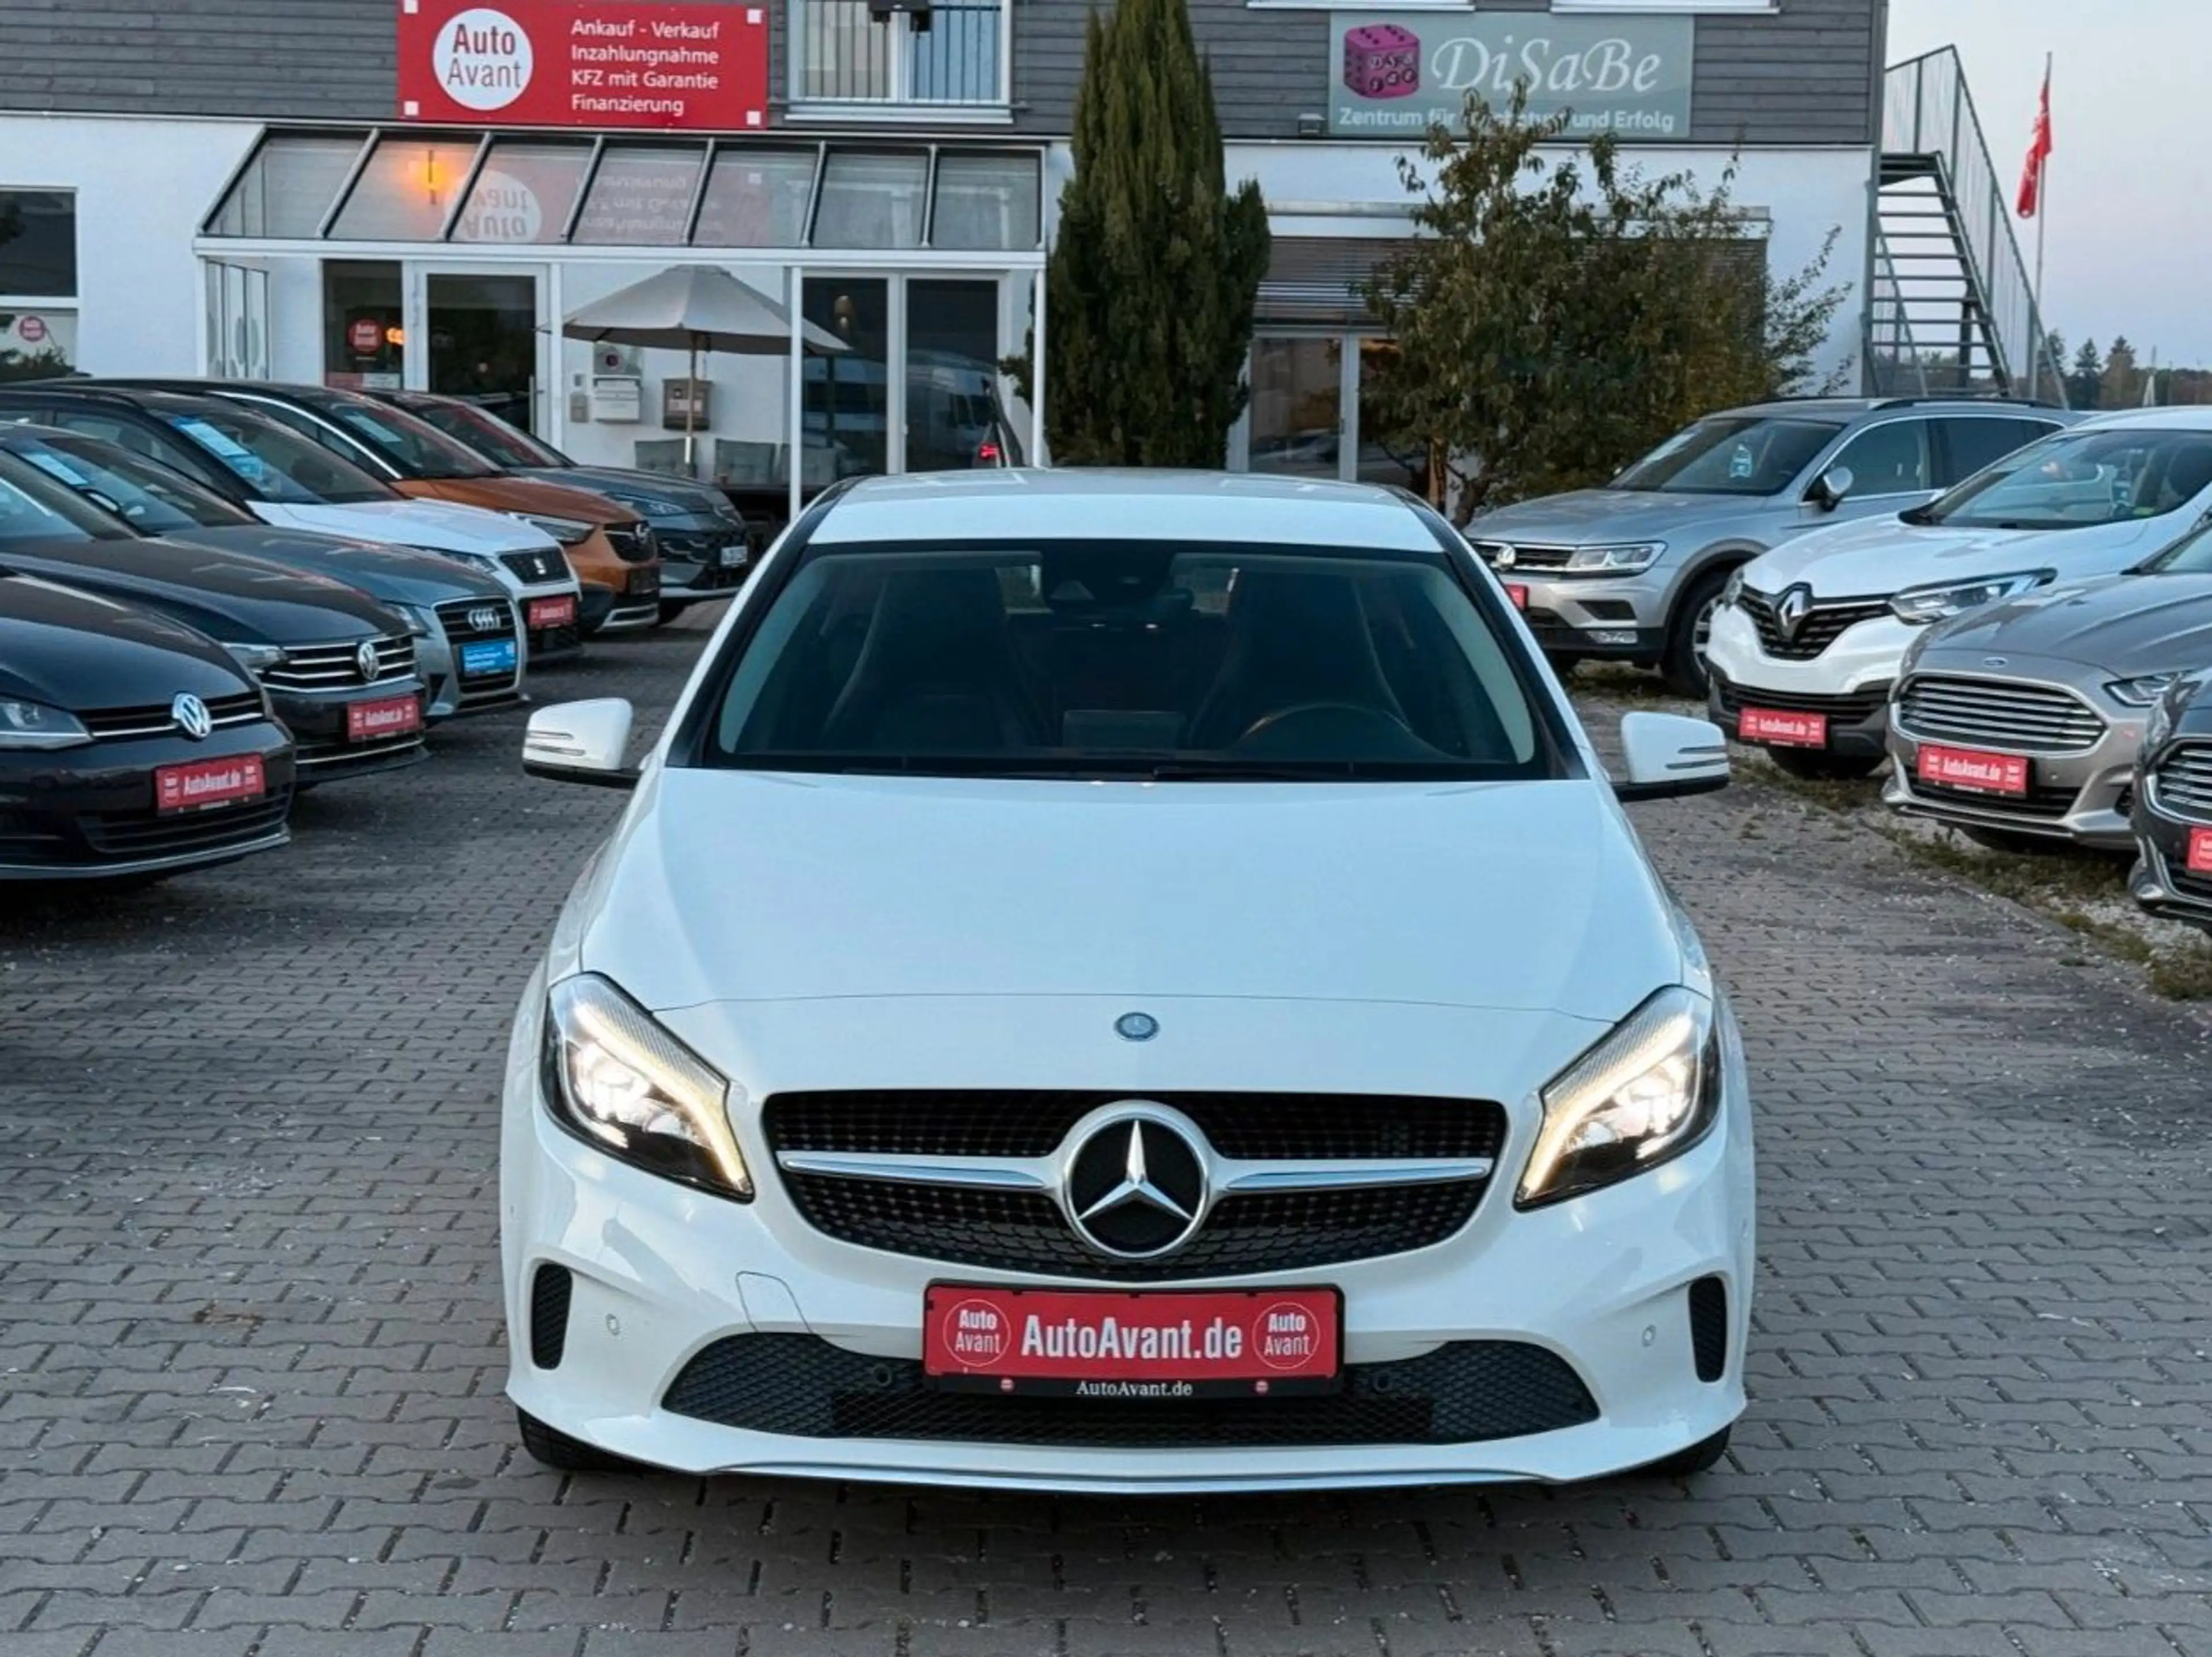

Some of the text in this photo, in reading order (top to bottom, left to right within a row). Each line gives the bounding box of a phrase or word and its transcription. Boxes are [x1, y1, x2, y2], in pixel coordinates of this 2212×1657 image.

[452, 23, 516, 55] Auto
[571, 18, 636, 37] Ankauf
[650, 20, 719, 39] Verkauf
[571, 44, 719, 66] Inzahlungnahme
[1431, 35, 1661, 94] DiSaBe
[447, 58, 521, 88] Avant
[571, 70, 718, 89] KFZ mit Garantie
[571, 94, 684, 117] Finanzierung
[1339, 107, 1423, 126] Zentrum
[1428, 107, 1456, 126] für
[1573, 110, 1609, 128] und
[1615, 111, 1675, 132] Erfolg
[959, 1309, 998, 1329] Auto
[1268, 1313, 1306, 1332] Auto
[955, 1331, 1000, 1353] Avant
[1021, 1315, 1243, 1359] AutoAvant.de
[1264, 1333, 1310, 1355] Avant
[1076, 1380, 1192, 1397] AutoAvant.de
